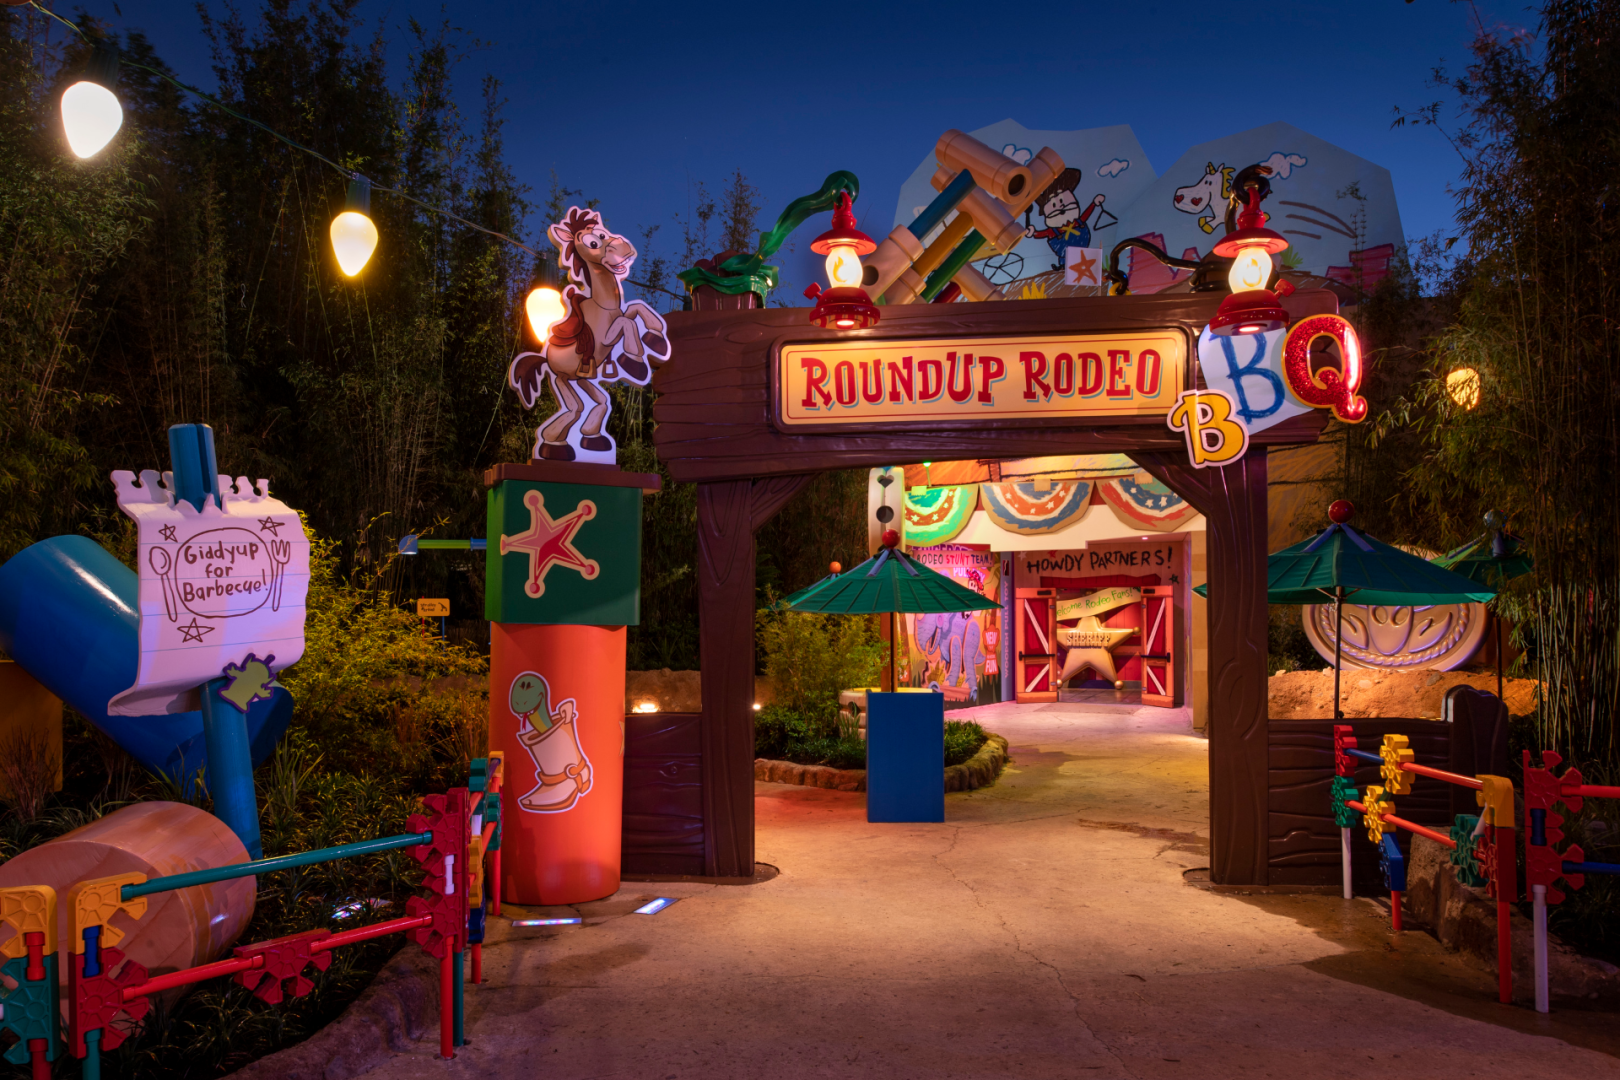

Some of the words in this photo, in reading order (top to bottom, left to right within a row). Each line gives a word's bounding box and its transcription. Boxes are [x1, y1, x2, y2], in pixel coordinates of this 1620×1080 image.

[800, 351, 1007, 411] ROUNDUP
[1019, 348, 1163, 402] RODEO
[184, 540, 259, 565] Giddyup
[916, 553, 944, 565] RODEO
[945, 553, 970, 566] STUNT
[970, 552, 994, 566] TEAM!
[1026, 553, 1085, 574] HOWDY
[1090, 546, 1173, 570] PARTNERS!
[205, 563, 233, 579] for
[183, 568, 269, 602] Barbecue!
[1056, 601, 1083, 617] elcome
[1085, 596, 1112, 609] Rodeo
[1111, 587, 1133, 601] Fans!
[1066, 632, 1111, 648] SHERIFF
[985, 659, 998, 673] FUN
